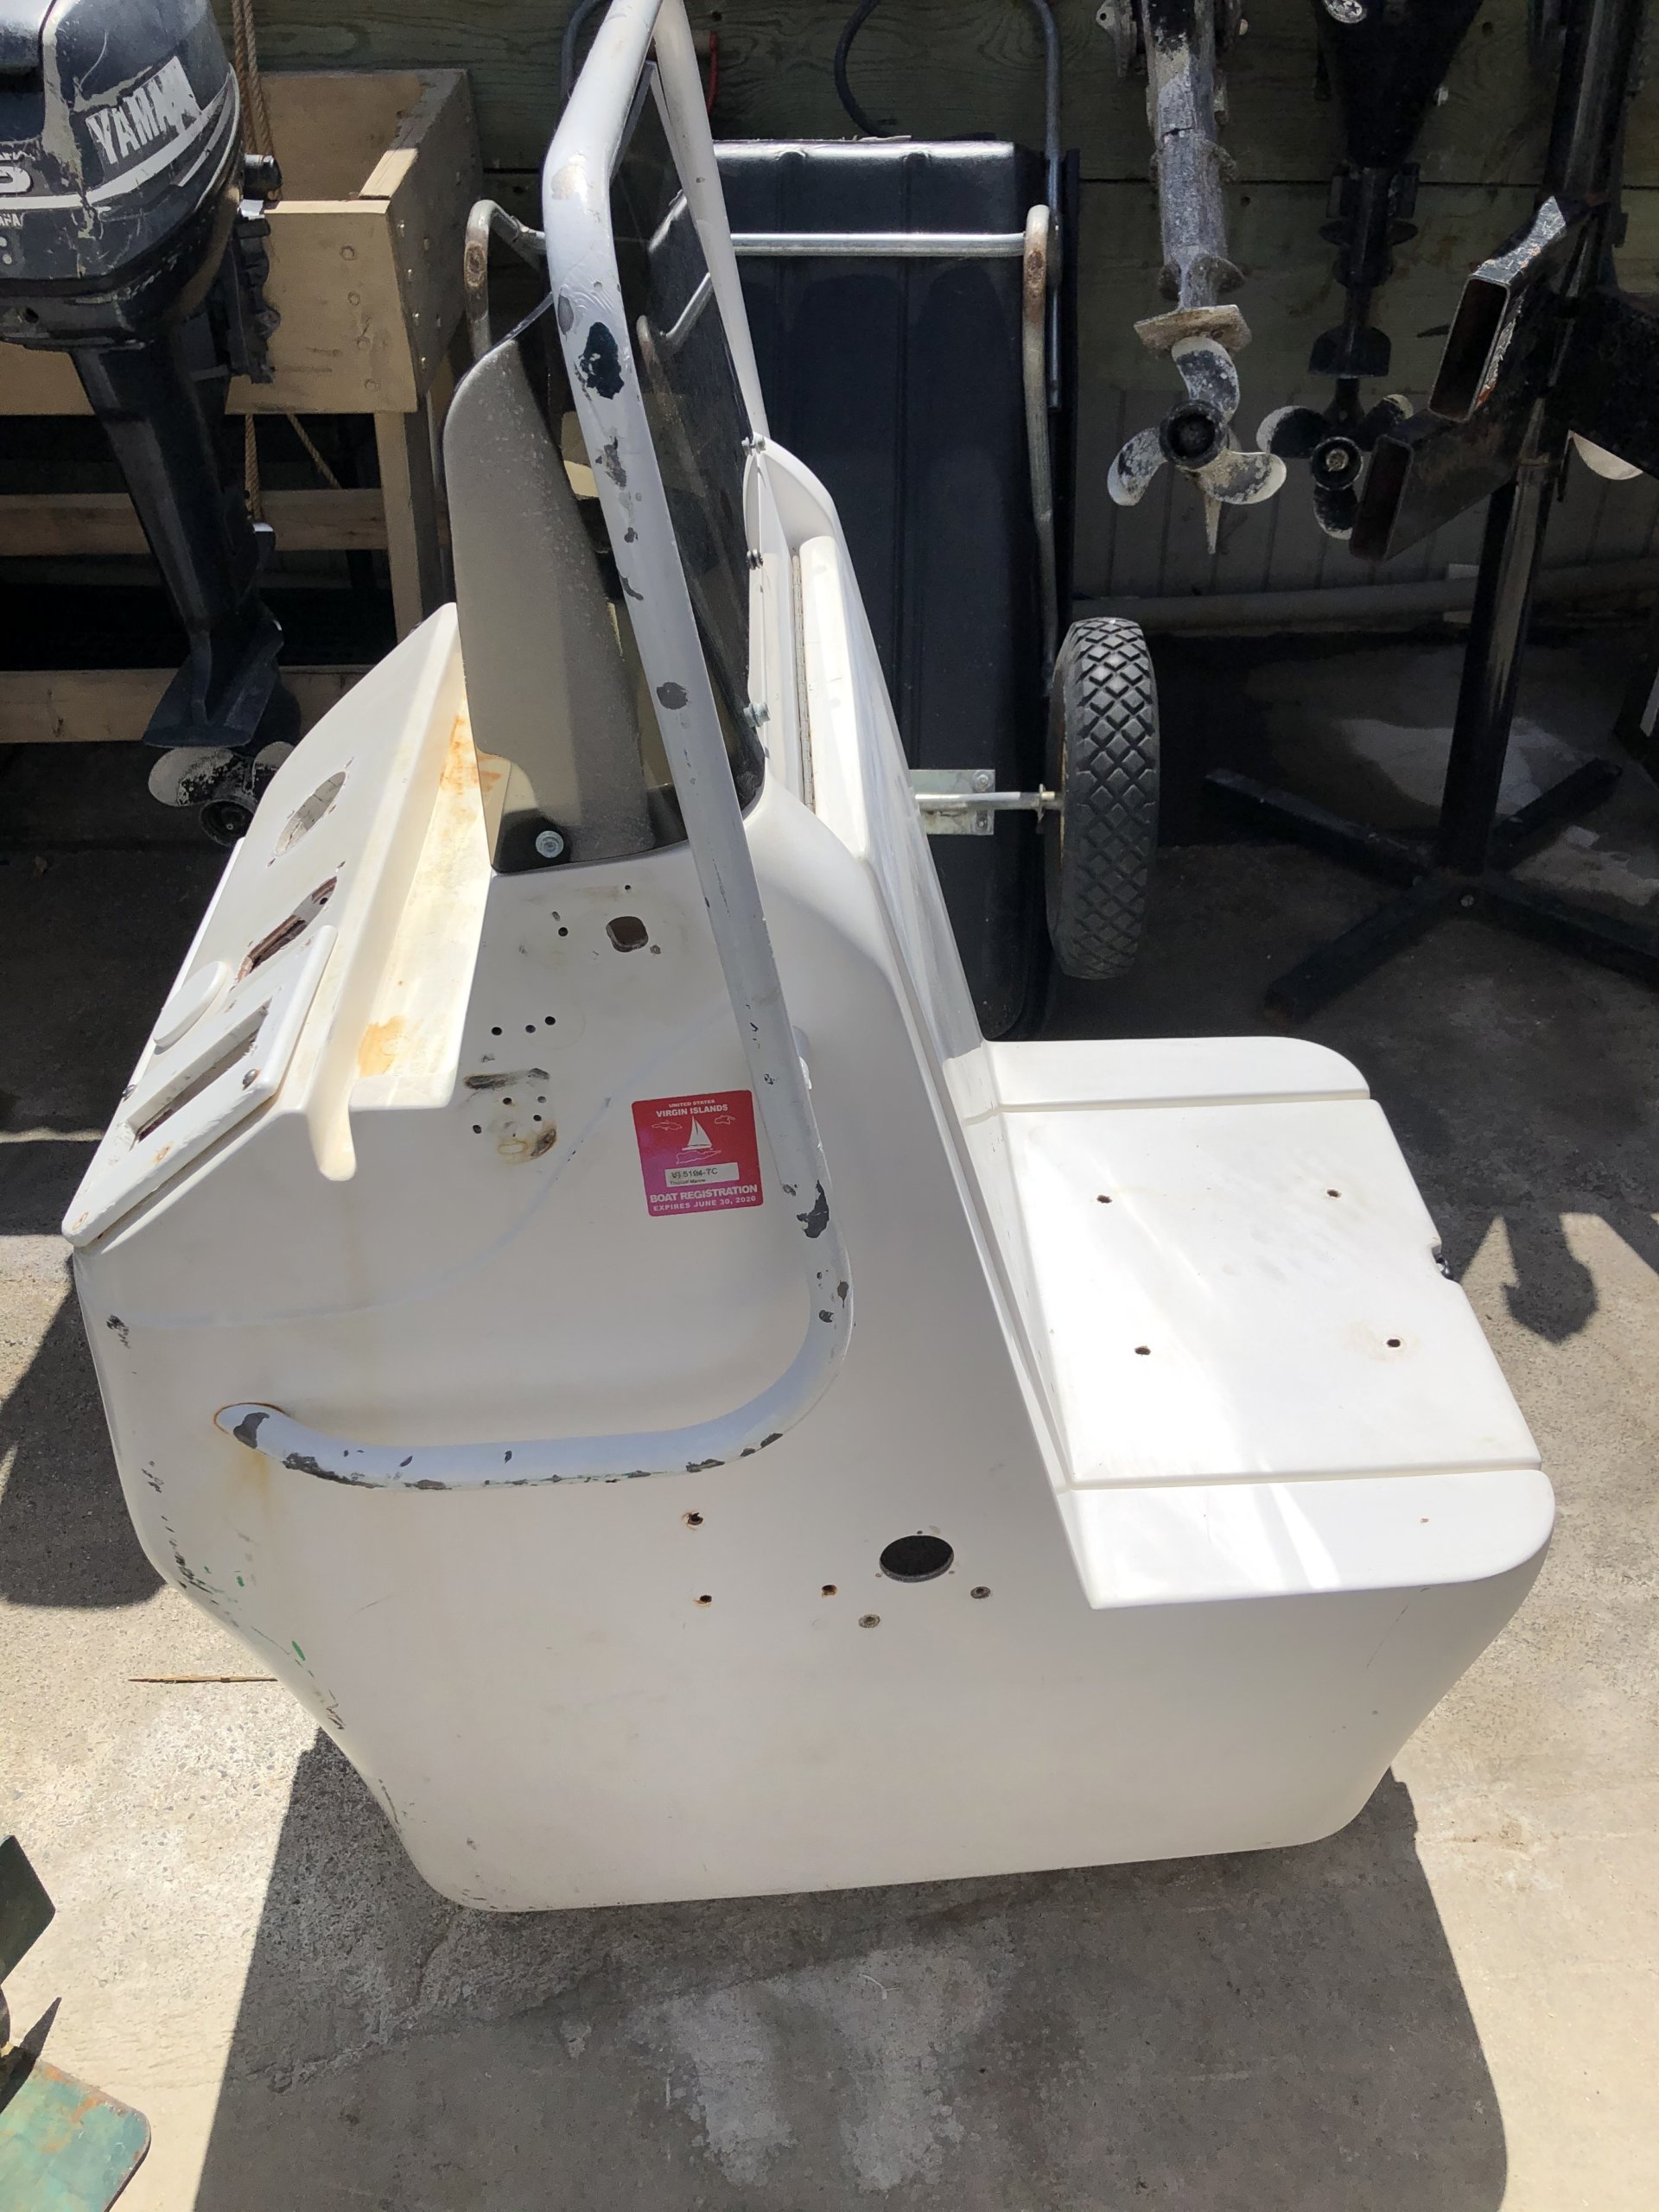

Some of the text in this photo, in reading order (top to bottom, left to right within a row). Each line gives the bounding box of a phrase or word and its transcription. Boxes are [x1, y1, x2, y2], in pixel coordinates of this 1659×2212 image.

[656, 1103, 728, 1118] VIRGIN ISLANDS
[650, 1184, 758, 1204] BOAT REGISTRATION
[653, 1202, 691, 1211] EXPIRES
[694, 1199, 717, 1208] JUNE
[735, 1195, 756, 1204] 2020
